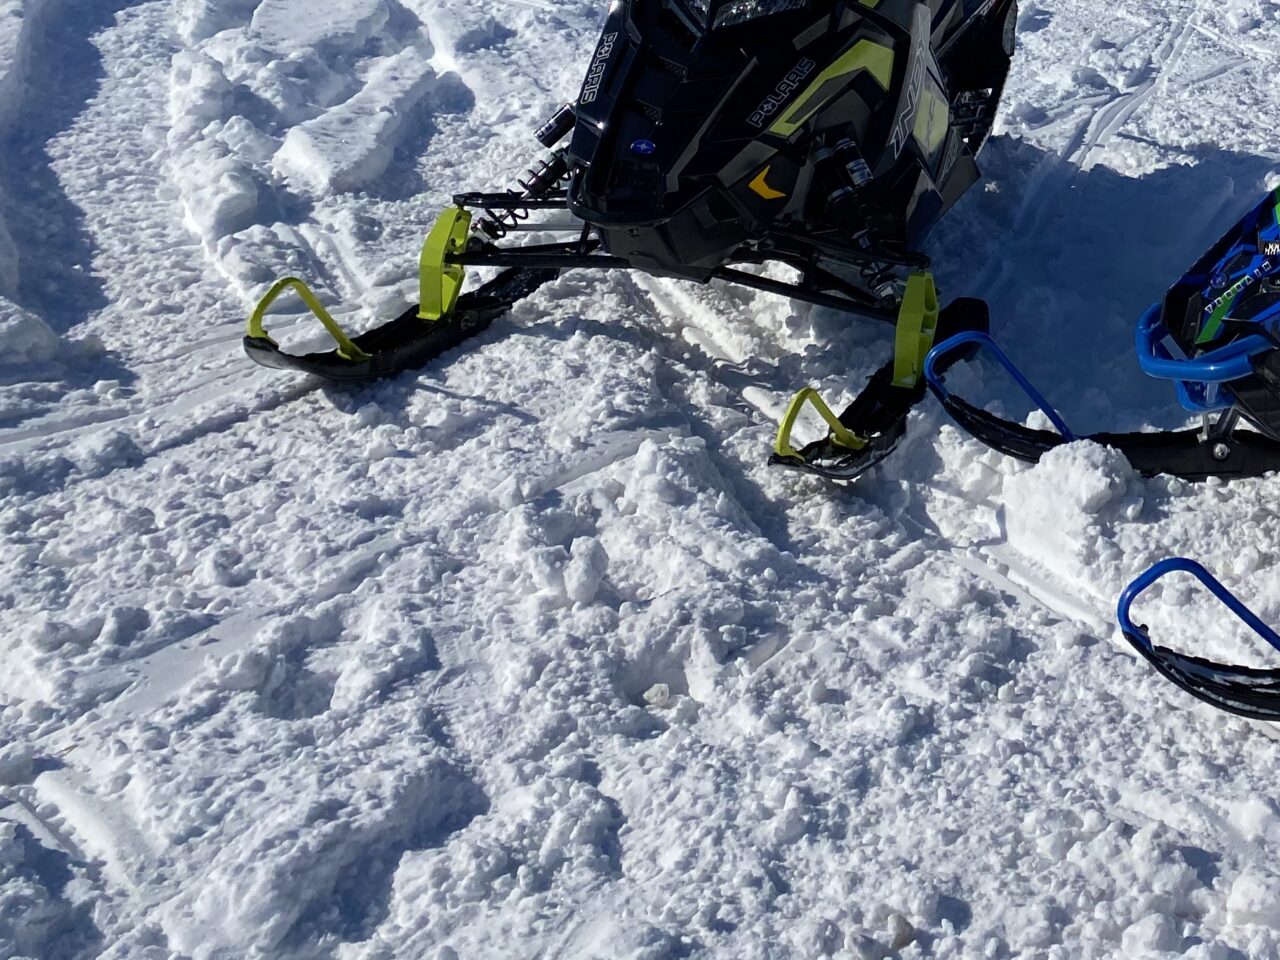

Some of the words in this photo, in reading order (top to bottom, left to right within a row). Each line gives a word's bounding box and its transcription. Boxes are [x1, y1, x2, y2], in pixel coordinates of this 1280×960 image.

[580, 31, 619, 105] POLARIS
[745, 56, 816, 128] POLARIS
[1204, 260, 1272, 314] TERRAIN
